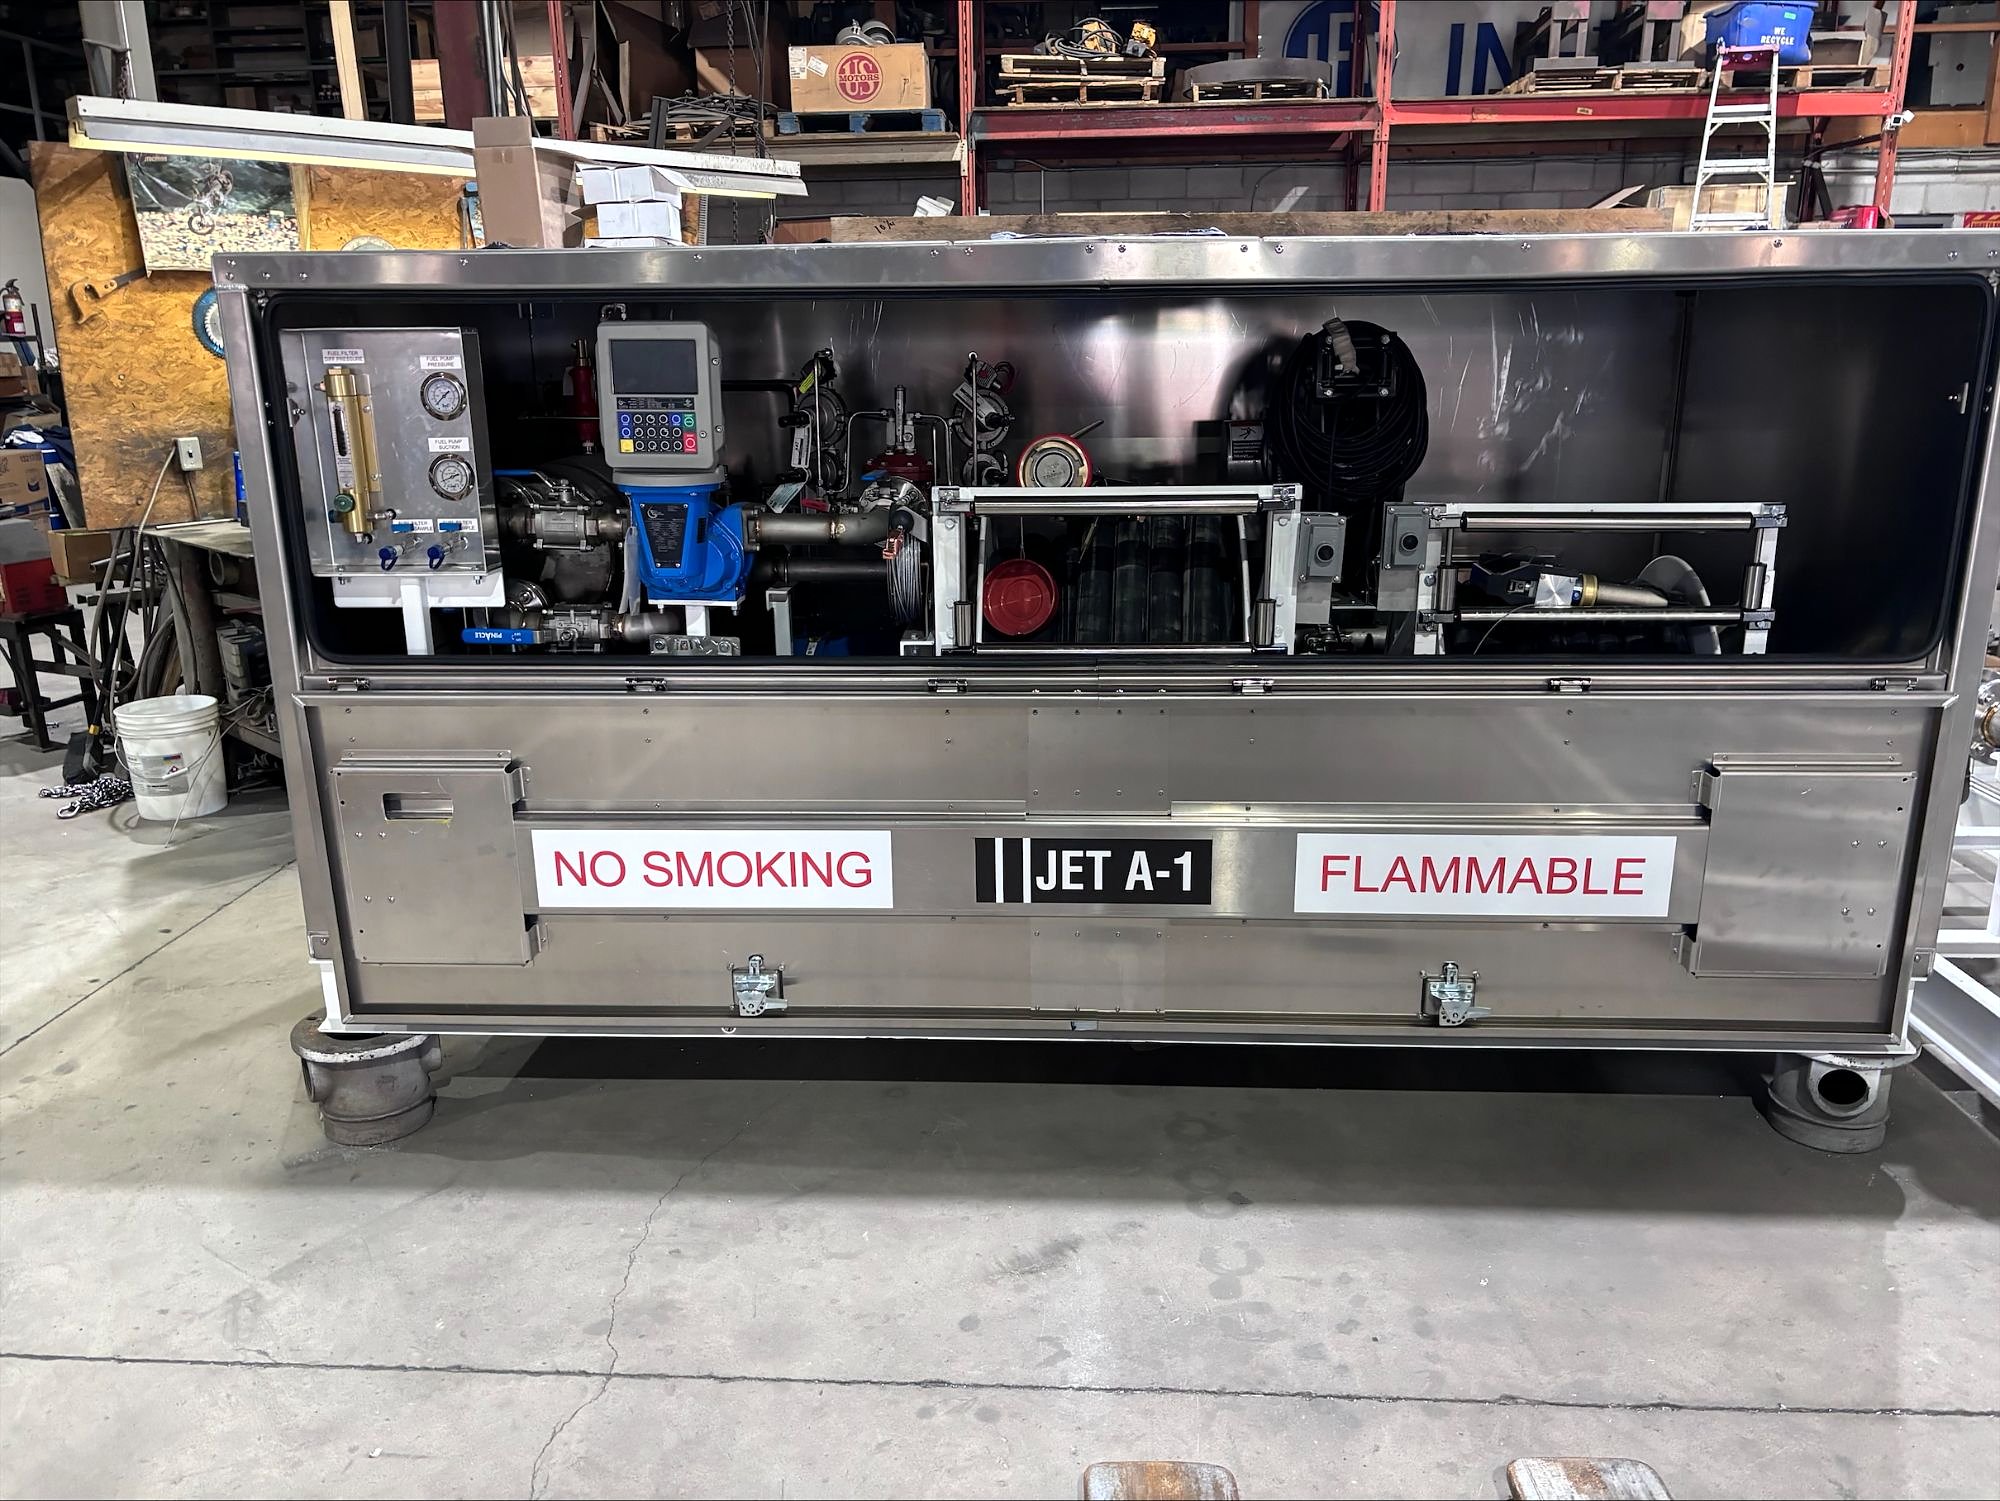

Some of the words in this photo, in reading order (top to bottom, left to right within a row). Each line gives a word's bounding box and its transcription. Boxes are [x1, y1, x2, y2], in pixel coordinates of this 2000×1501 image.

[1760, 36, 1795, 46] RECYCLE
[1774, 27, 1786, 35] WE
[554, 850, 626, 888] NO
[643, 850, 872, 888] SMOKING
[1035, 850, 1112, 890] JET
[1124, 850, 1192, 892] A-1
[1321, 855, 1646, 895] FLAMMABLE
